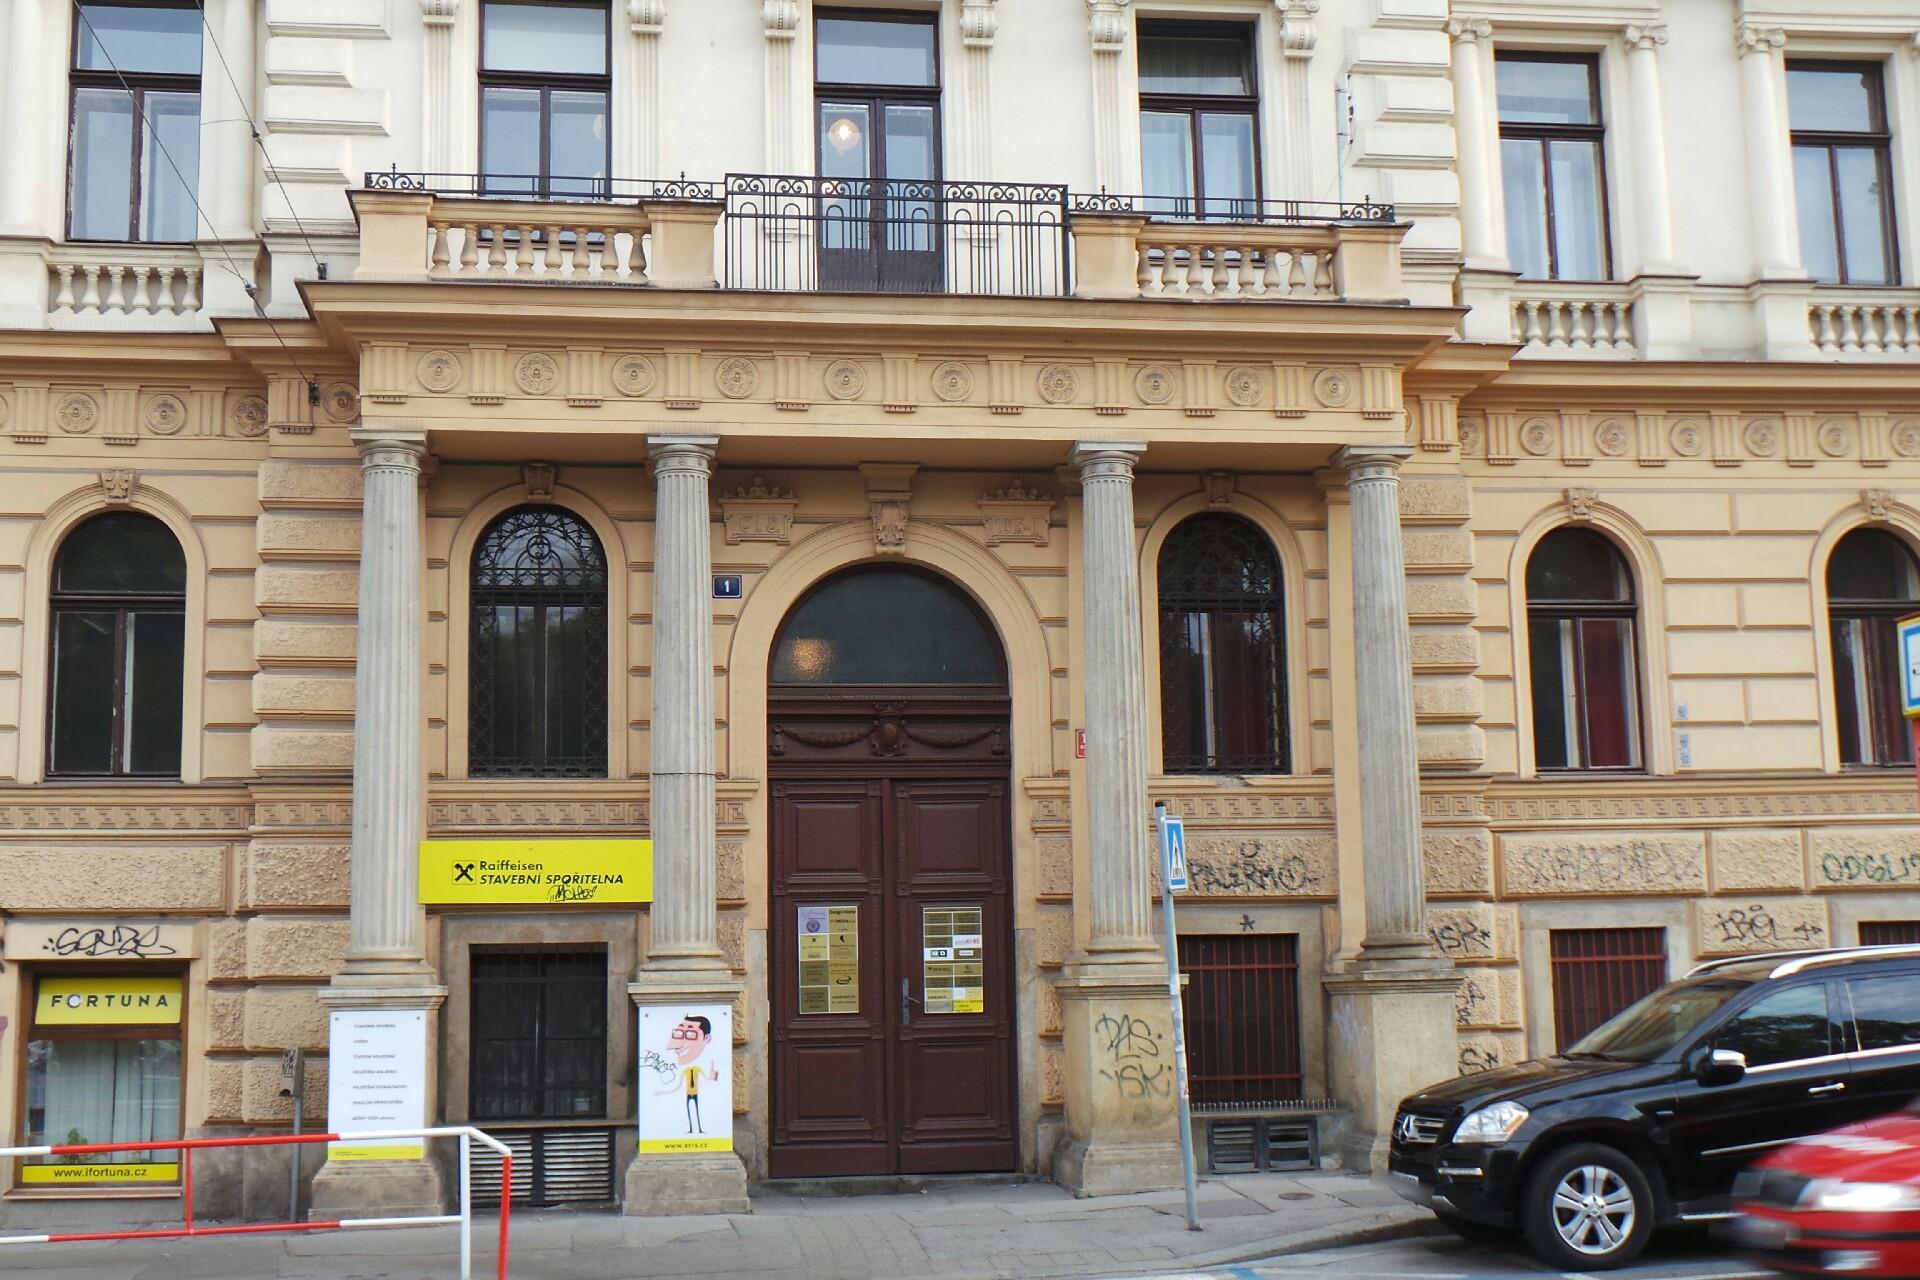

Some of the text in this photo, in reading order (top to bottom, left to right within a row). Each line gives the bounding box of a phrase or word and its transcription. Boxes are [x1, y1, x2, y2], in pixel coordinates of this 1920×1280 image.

[479, 860, 543, 871] Raiffeisen
[480, 872, 624, 885] STAVEBNÍ SPOŘITELNA
[51, 994, 169, 1009] FORTUNA
[54, 1167, 148, 1177] www.ifortuna.cz
